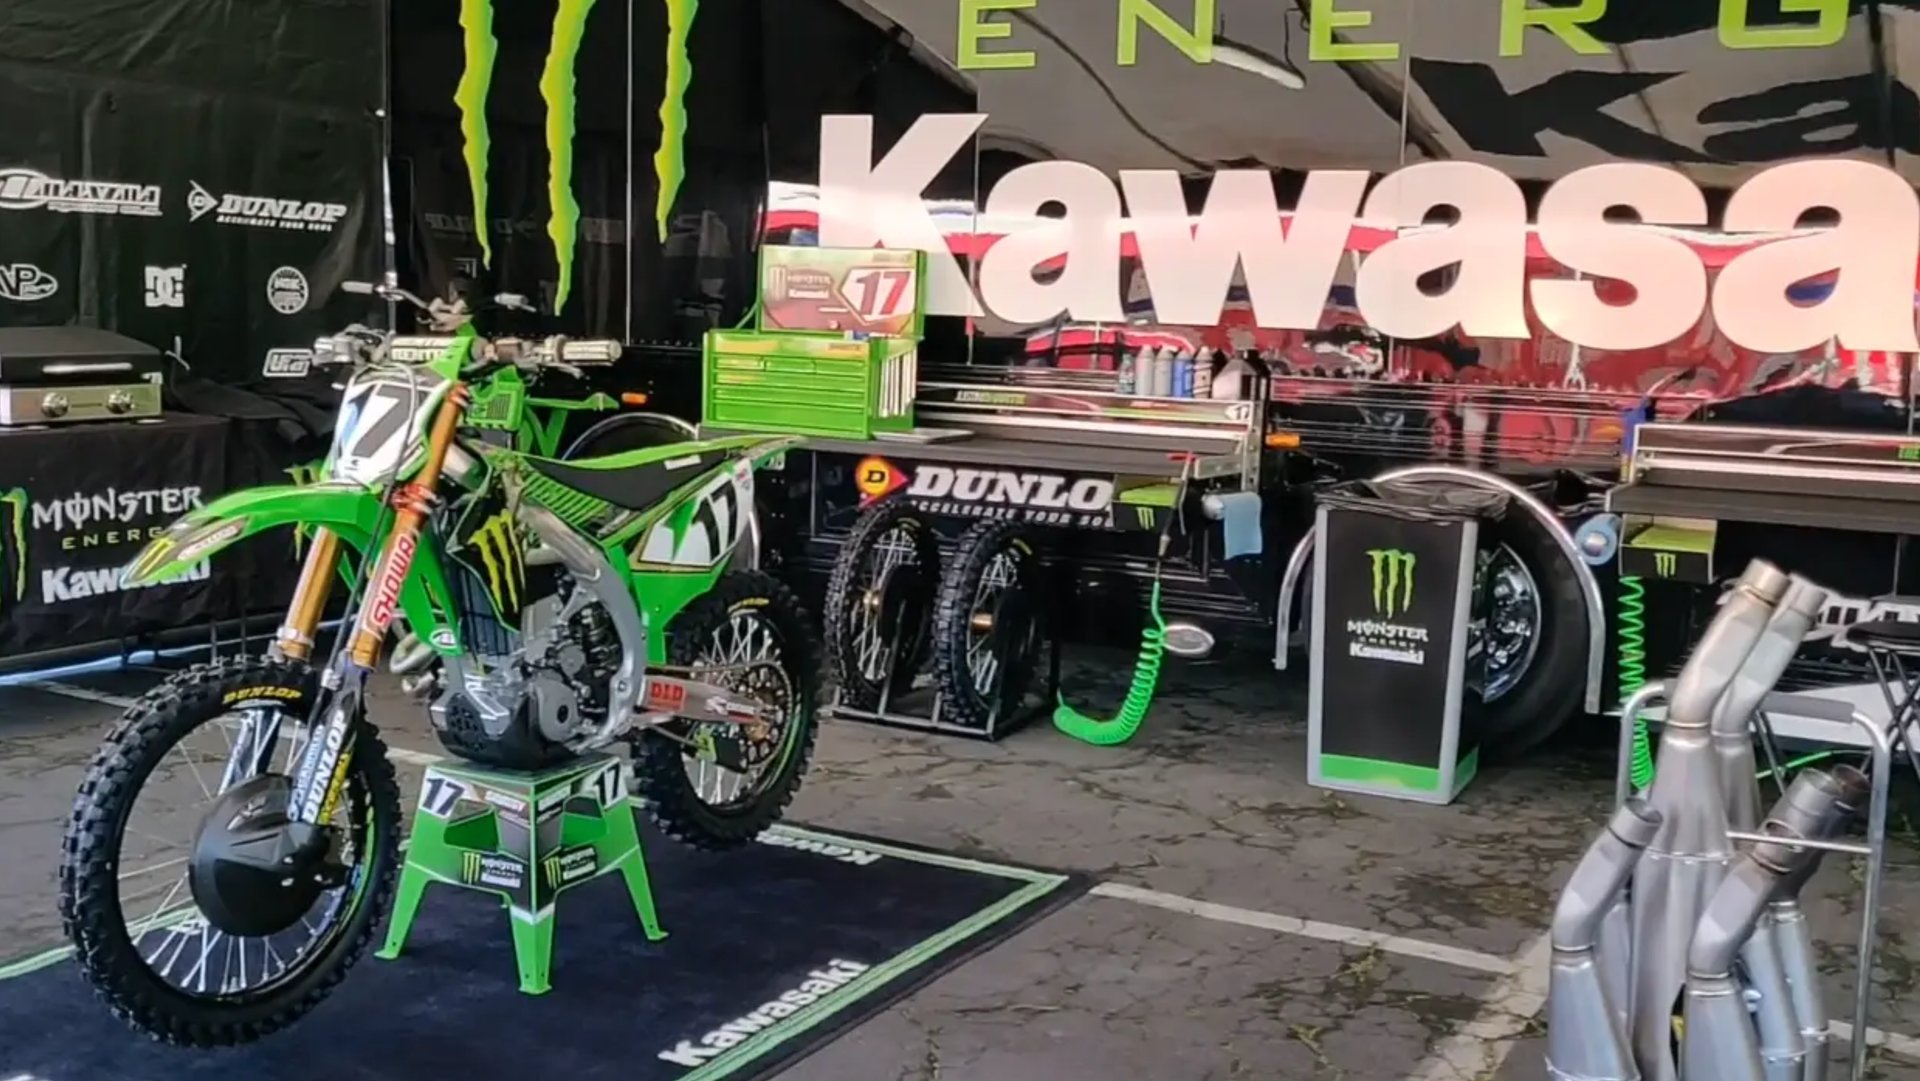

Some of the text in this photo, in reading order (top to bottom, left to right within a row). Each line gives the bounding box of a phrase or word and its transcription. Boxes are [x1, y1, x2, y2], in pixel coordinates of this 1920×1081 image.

[217, 194, 347, 222] DUNLOP
[856, 271, 911, 316] 17
[342, 383, 432, 458] 17
[32, 486, 207, 531] MONSTER
[911, 500, 1016, 520] CCELERATE
[1024, 509, 1072, 524] YOUR
[373, 533, 415, 623] SHOWA
[1347, 620, 1429, 642] MONSTER
[222, 685, 302, 705] DUNLOP
[302, 709, 346, 824] DUNLOP
[592, 763, 621, 808] 17
[423, 777, 465, 816] 17
[658, 958, 870, 1068] Kawasaki
